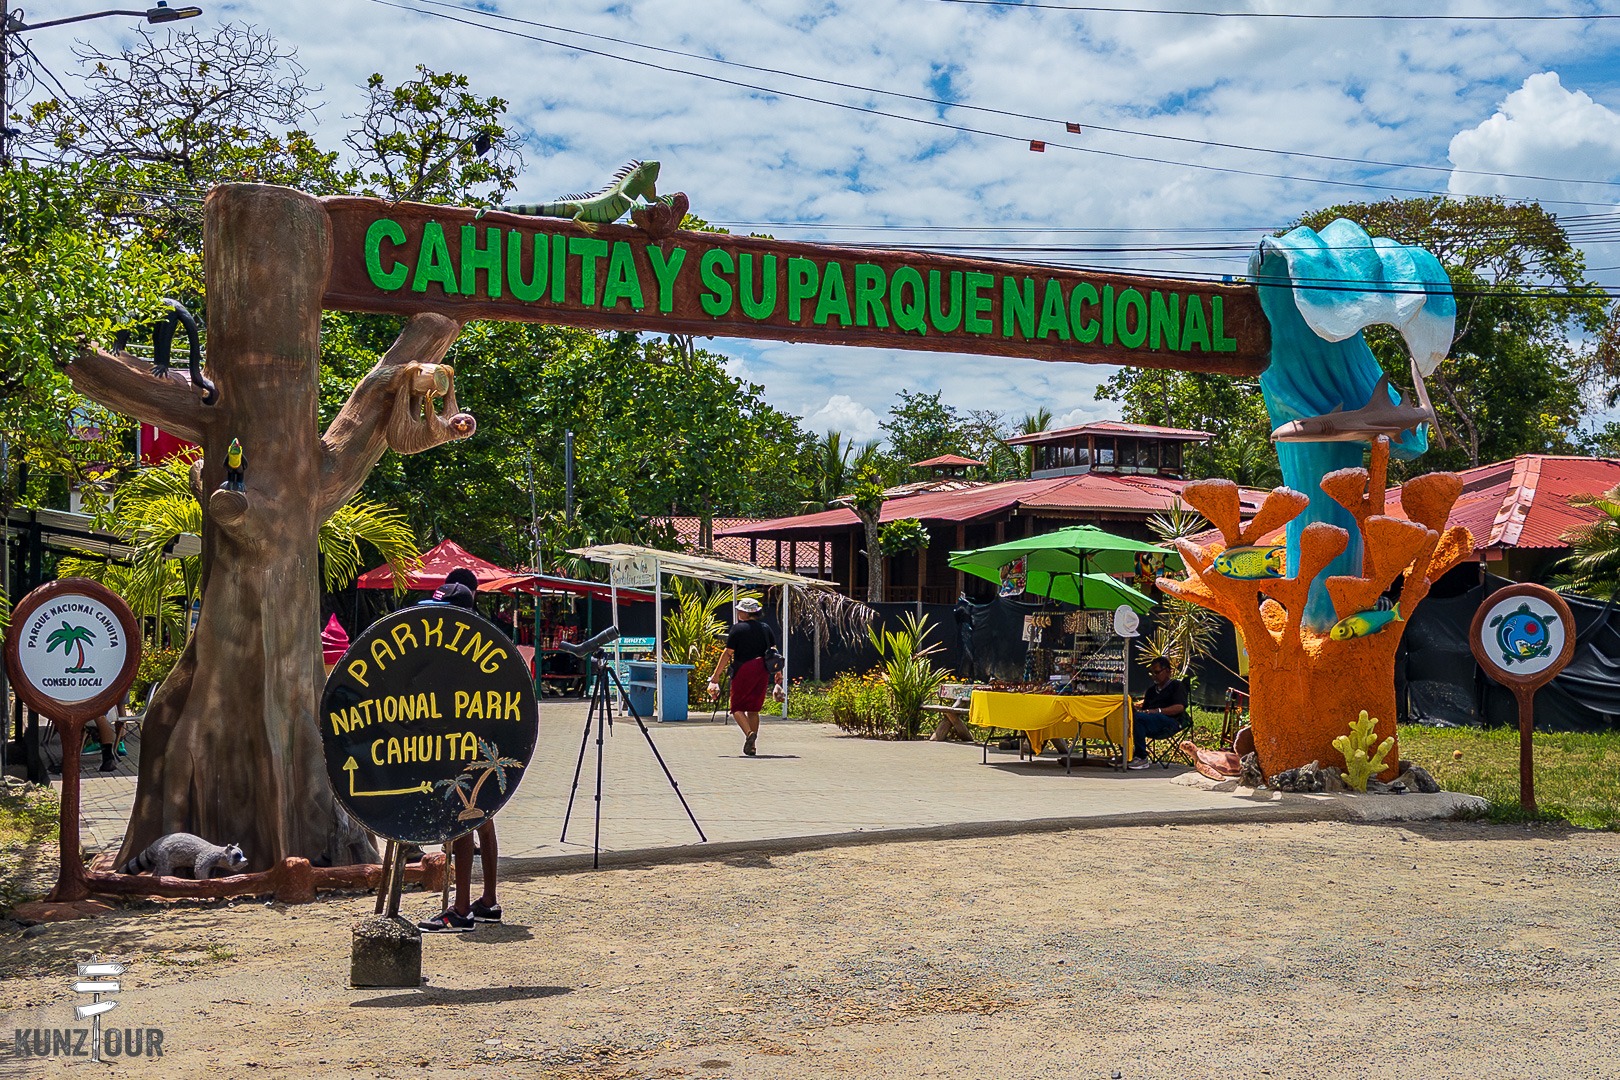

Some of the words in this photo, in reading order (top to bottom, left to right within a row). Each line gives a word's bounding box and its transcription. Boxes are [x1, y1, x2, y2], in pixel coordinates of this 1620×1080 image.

[364, 218, 645, 310] CAHUITA
[645, 243, 687, 313] Y
[699, 247, 777, 321] SU
[787, 256, 995, 337] PARQUE
[1002, 275, 1237, 353] NACIONAL
[28, 611, 50, 648] PARQUE
[50, 603, 94, 617] NACIONAL
[95, 611, 119, 648] CAHUITA
[347, 617, 508, 688] PARKING
[42, 677, 77, 687] CONSEJO
[78, 677, 103, 687] LOCAL
[330, 692, 442, 736] NATIONAL
[454, 690, 521, 721] PARK
[371, 731, 478, 765] CAHUITA
